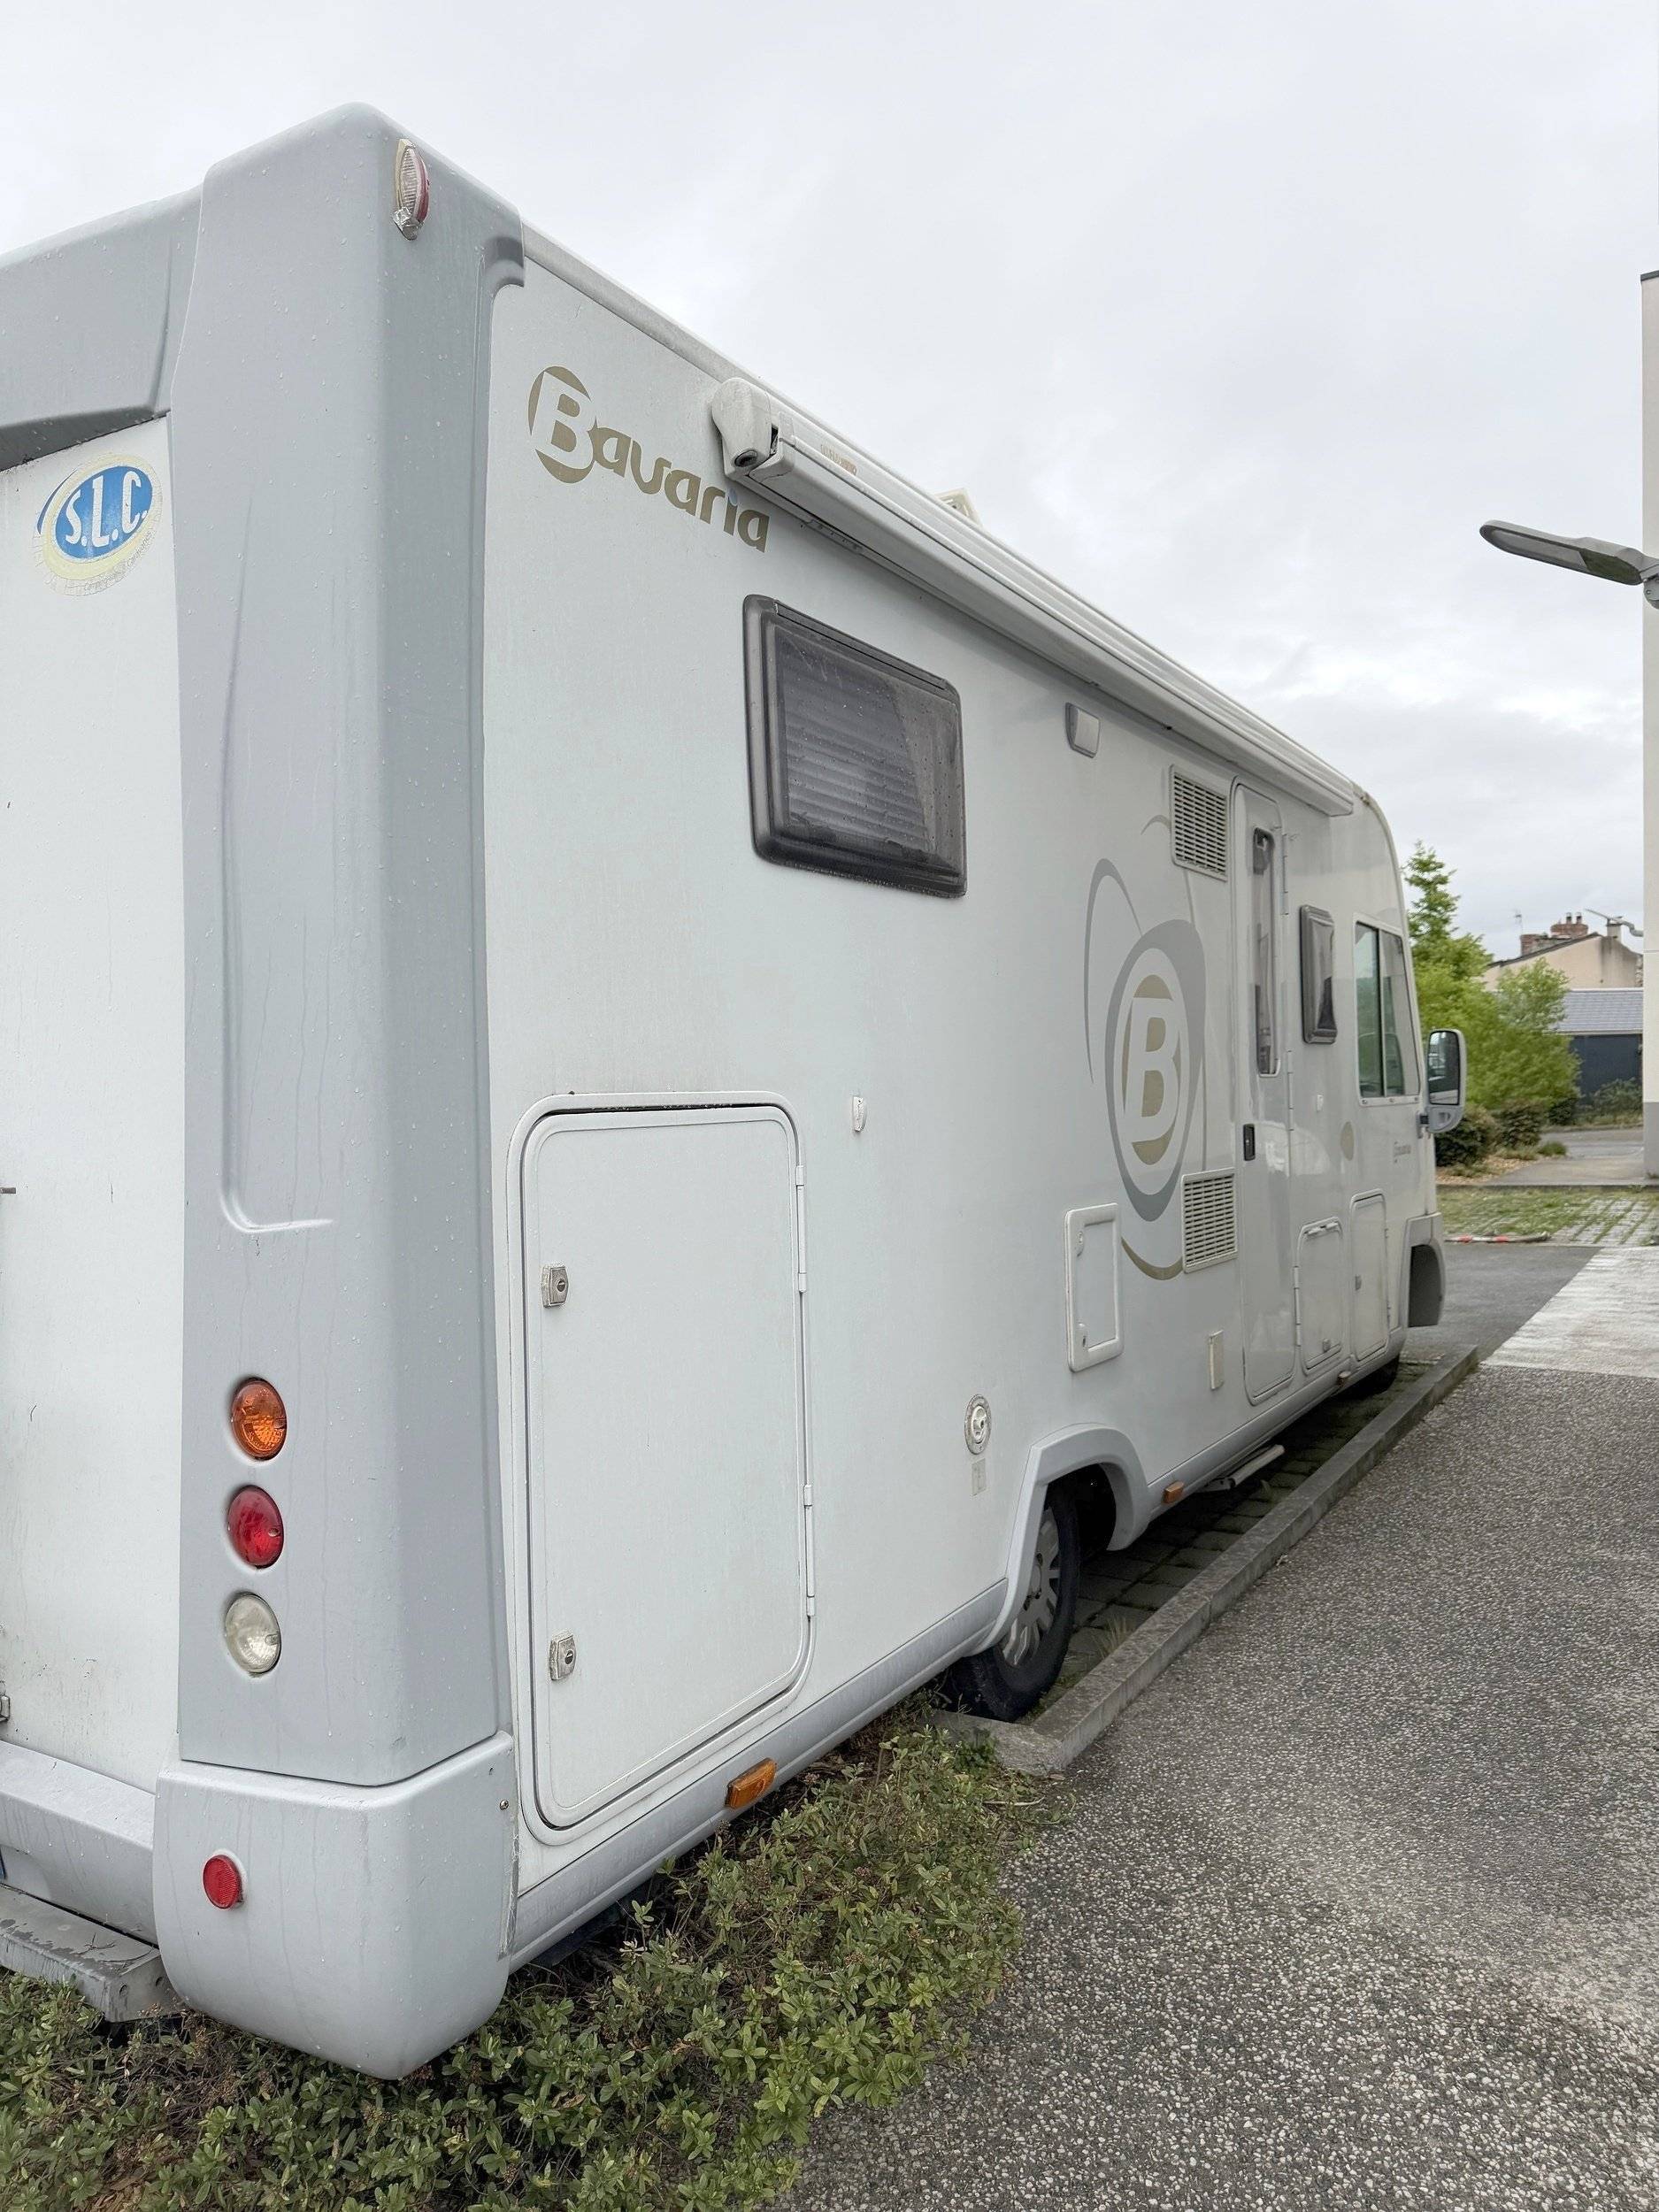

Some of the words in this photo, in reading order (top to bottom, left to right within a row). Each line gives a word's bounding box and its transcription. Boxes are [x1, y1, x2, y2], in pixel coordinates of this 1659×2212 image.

[65, 471, 148, 547] S.L.C.
[528, 365, 770, 553] Bavaria
[1123, 995, 1181, 1145] B
